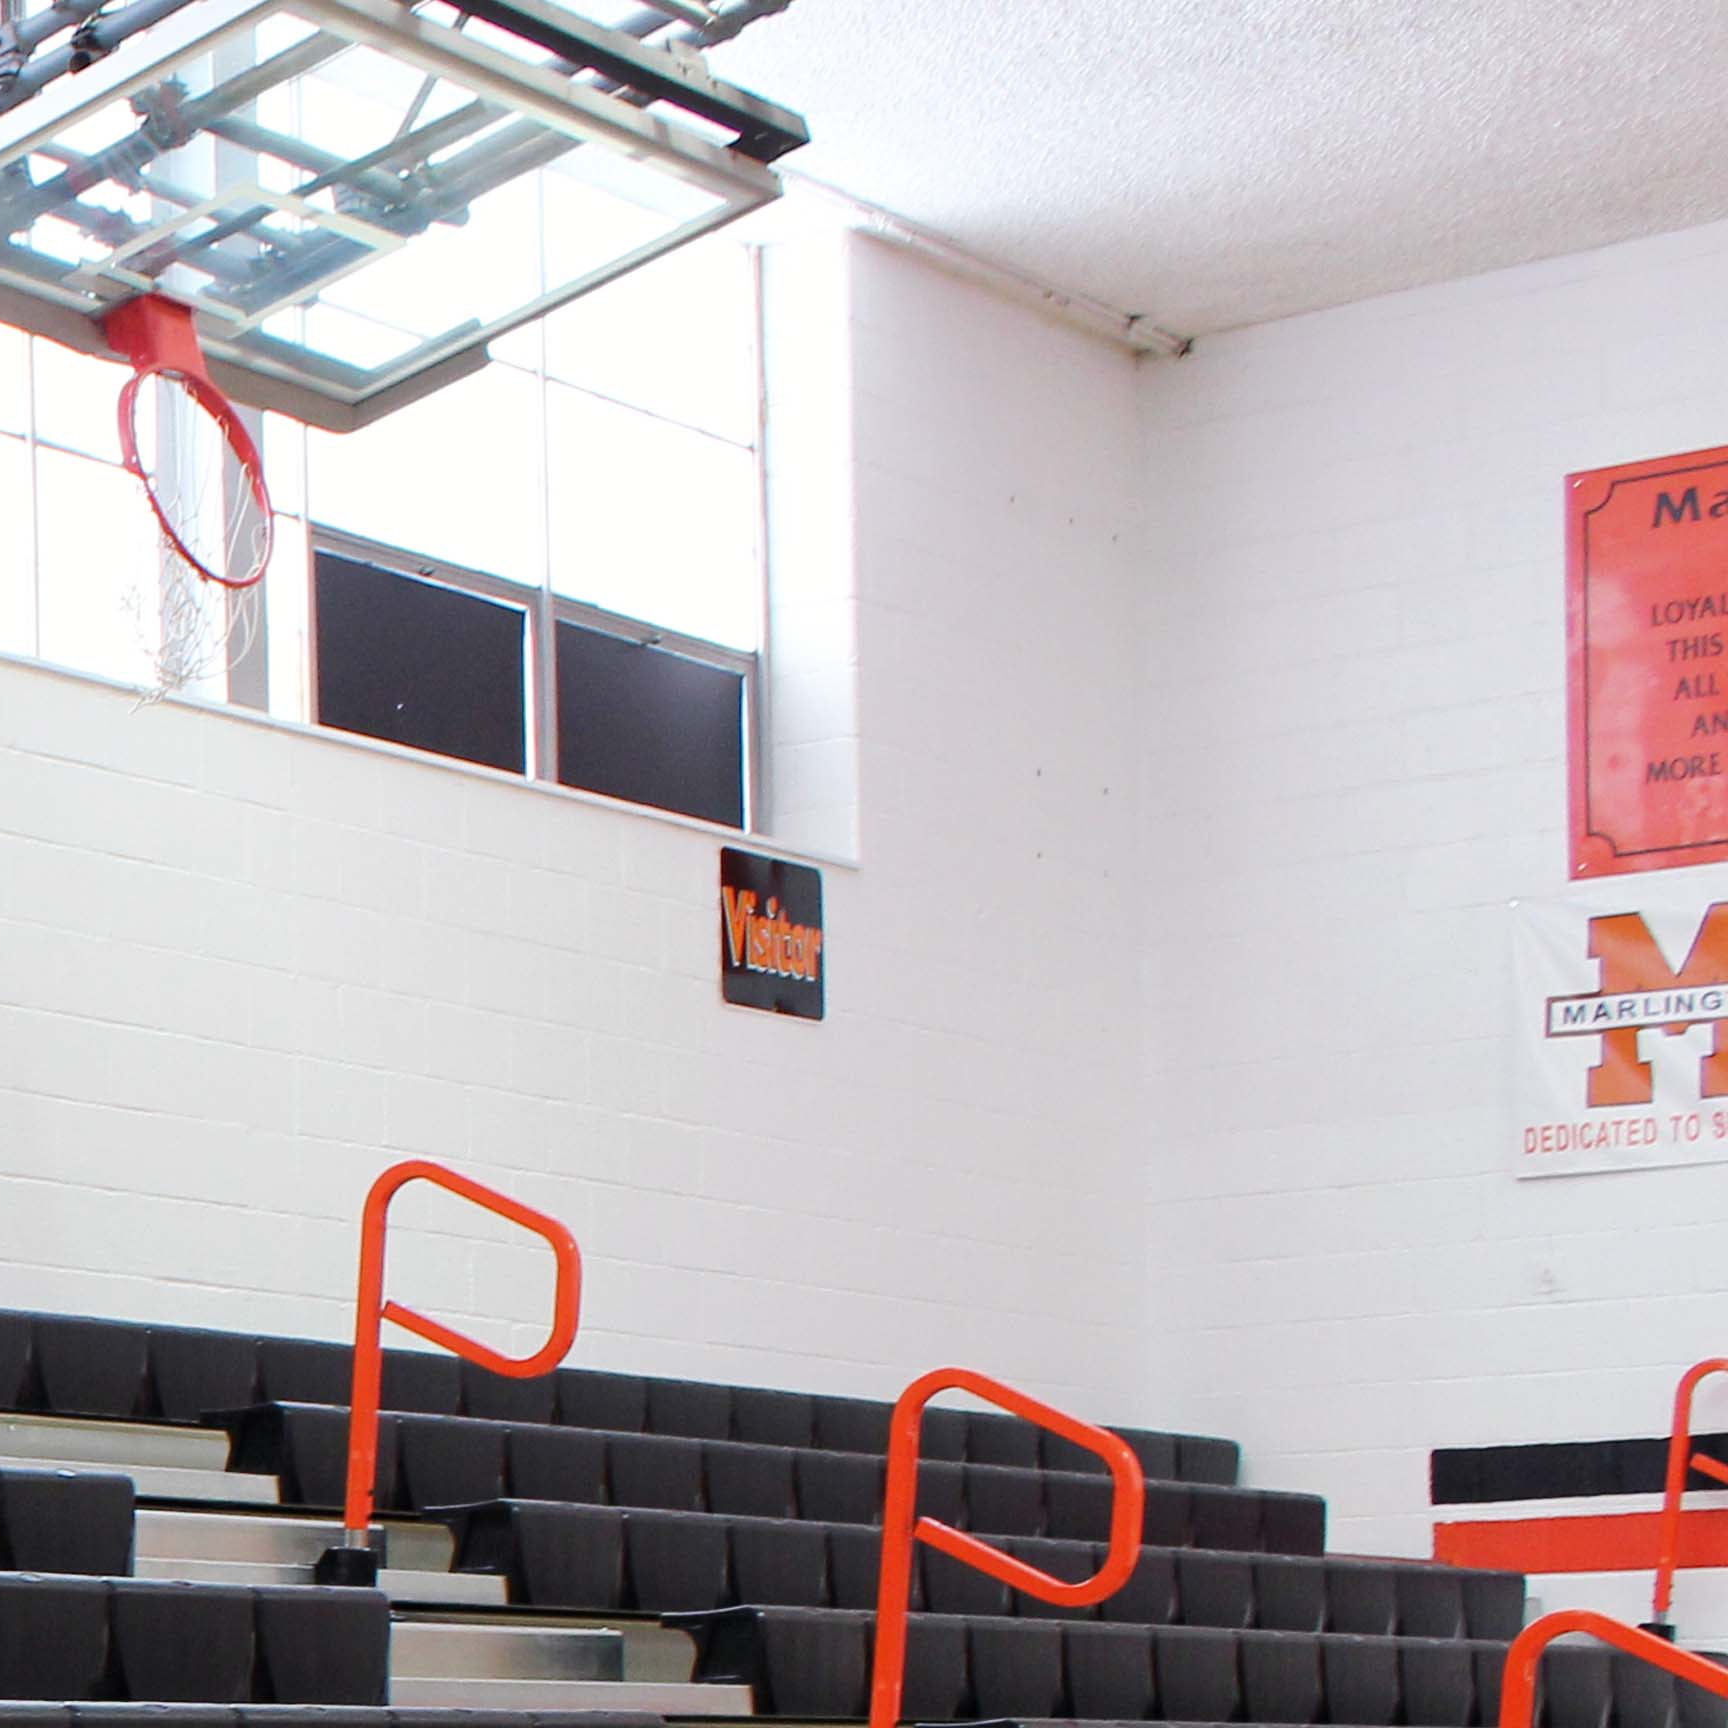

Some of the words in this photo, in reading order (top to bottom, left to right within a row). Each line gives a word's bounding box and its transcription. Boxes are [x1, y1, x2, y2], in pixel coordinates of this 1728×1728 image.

[1667, 632, 1724, 662] THIS
[1674, 674, 1720, 700] ALL
[1645, 752, 1722, 784] MORE
[722, 886, 823, 982] Visitor
[1524, 1116, 1658, 1154] DEDICATED
[1670, 1112, 1701, 1144] TO
